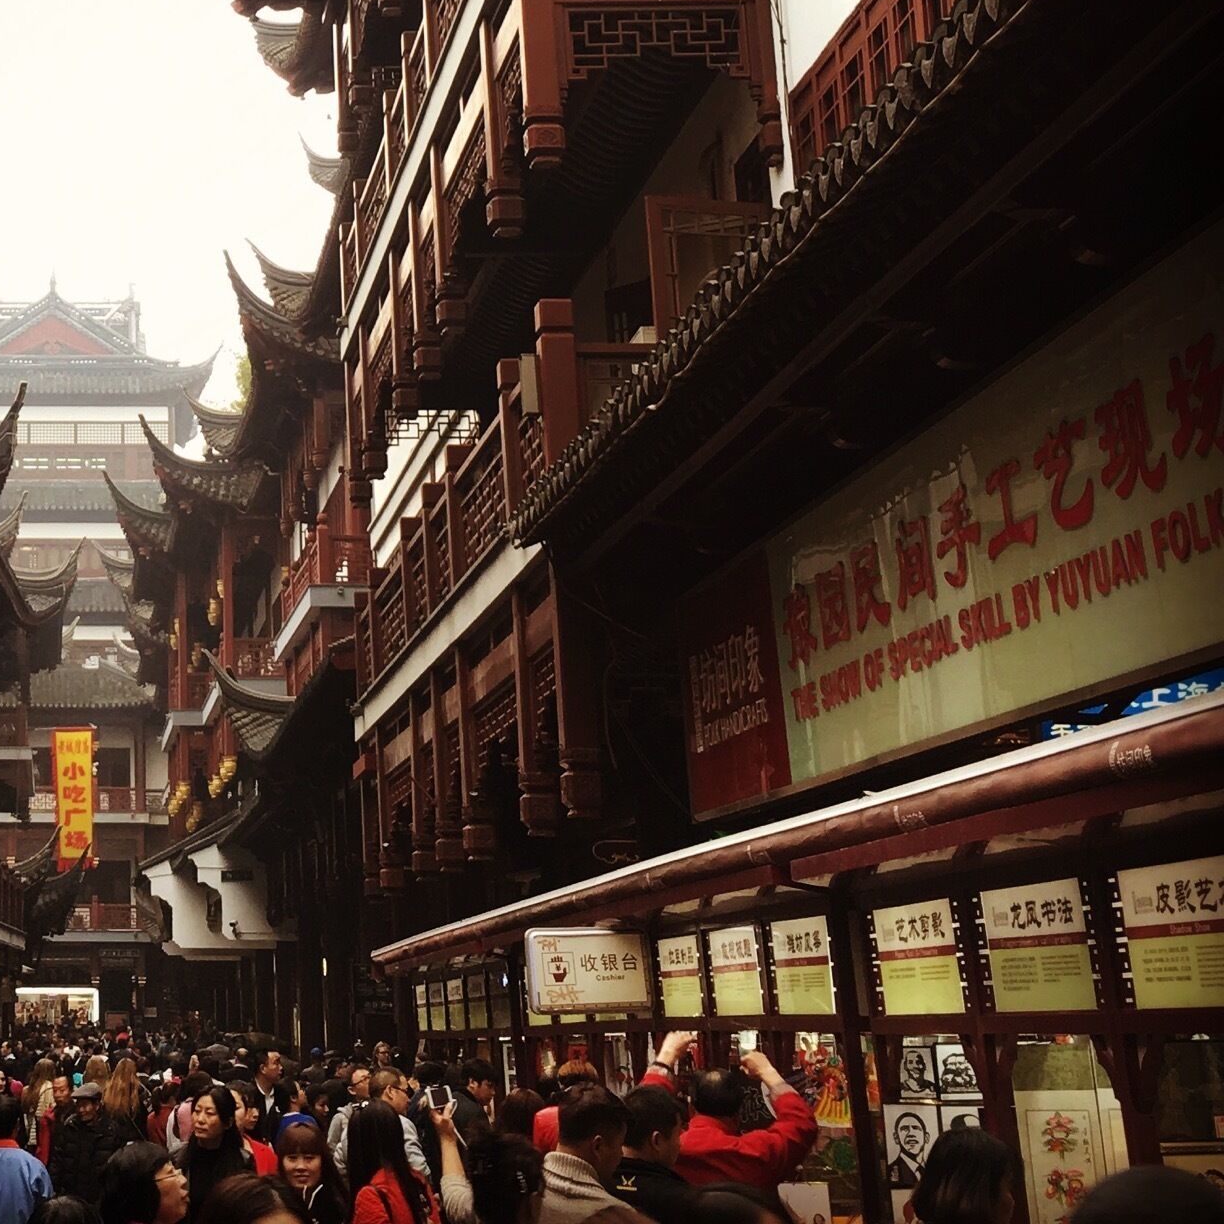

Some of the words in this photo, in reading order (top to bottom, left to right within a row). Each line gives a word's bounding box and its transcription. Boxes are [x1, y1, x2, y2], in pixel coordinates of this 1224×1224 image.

[783, 333, 1224, 670] 豫园民间手工艺现场
[791, 682, 819, 721] THE
[820, 660, 861, 711] SHOW
[864, 648, 884, 692] OF
[888, 615, 958, 681] SPECIAL
[959, 593, 1012, 651] SKILL
[1012, 576, 1041, 631] BY
[1044, 530, 1148, 617] YUYUAN
[1151, 488, 1224, 572] FOLK
[1142, 681, 1224, 709] 上海
[63, 762, 88, 849] 小吃广场
[580, 953, 637, 972] 收银台
